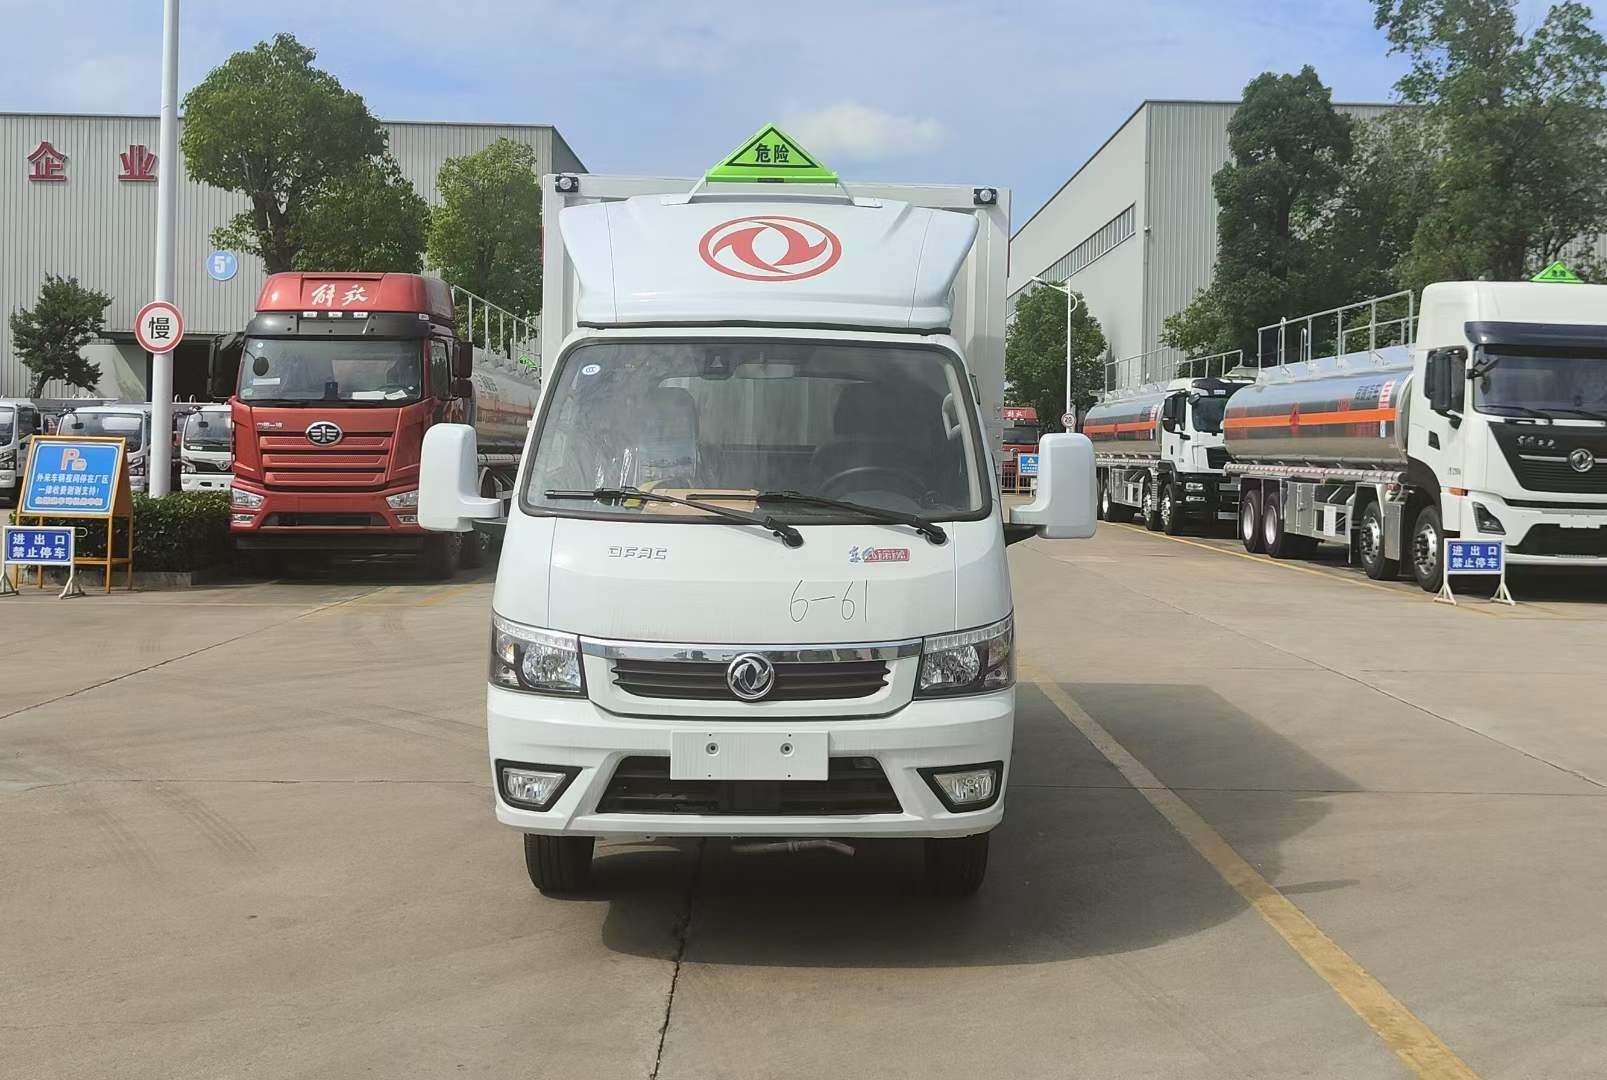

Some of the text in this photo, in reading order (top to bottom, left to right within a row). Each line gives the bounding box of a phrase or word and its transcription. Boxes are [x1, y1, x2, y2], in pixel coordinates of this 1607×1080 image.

[27, 140, 157, 182] 企业
[755, 143, 790, 163] 危险
[311, 283, 369, 307] 解放
[148, 316, 170, 340] 慢
[12, 533, 65, 545] 进出口
[12, 546, 66, 558] 禁止停车
[608, 545, 667, 560] DFAC
[1452, 545, 1497, 556] 进出口
[1452, 557, 1498, 568] 禁止停车
[789, 579, 868, 623] 6-61
